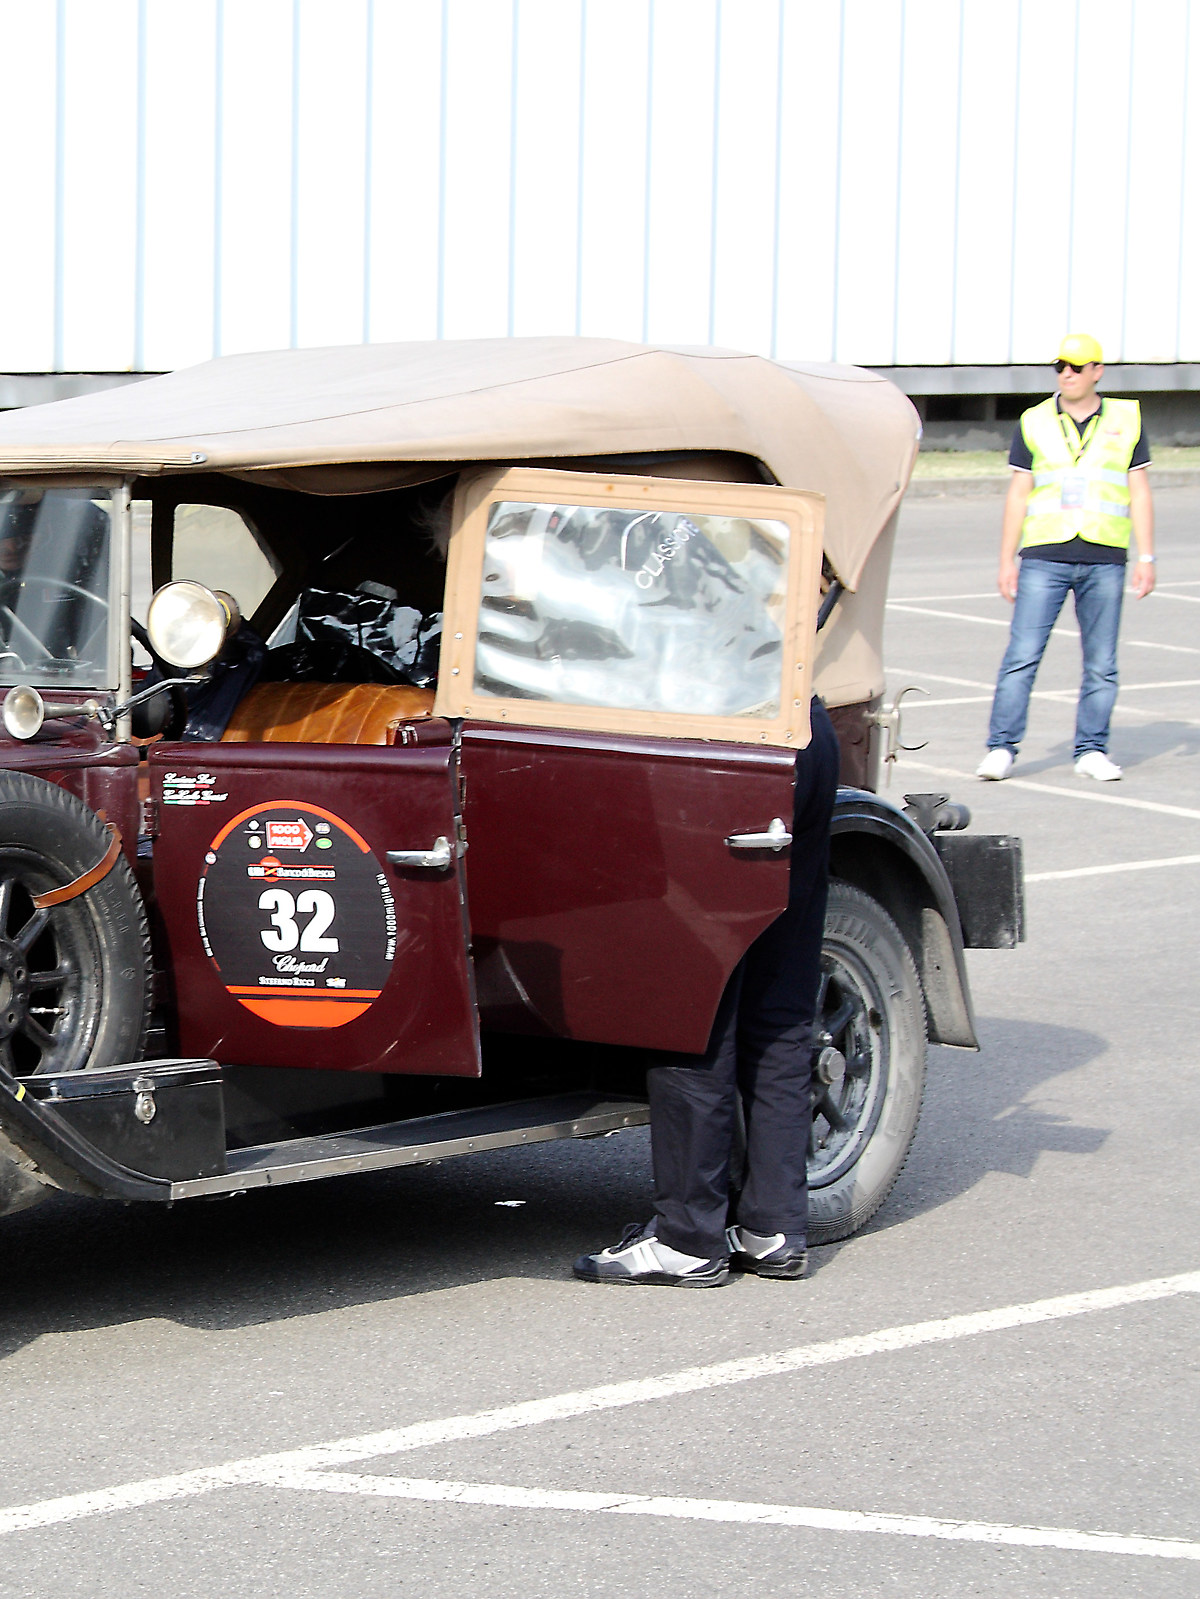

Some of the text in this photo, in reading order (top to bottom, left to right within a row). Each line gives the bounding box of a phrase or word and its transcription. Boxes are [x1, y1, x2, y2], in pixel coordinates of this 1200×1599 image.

[270, 825, 301, 835] 1000
[258, 888, 340, 952] 32
[271, 954, 330, 975] Chopard
